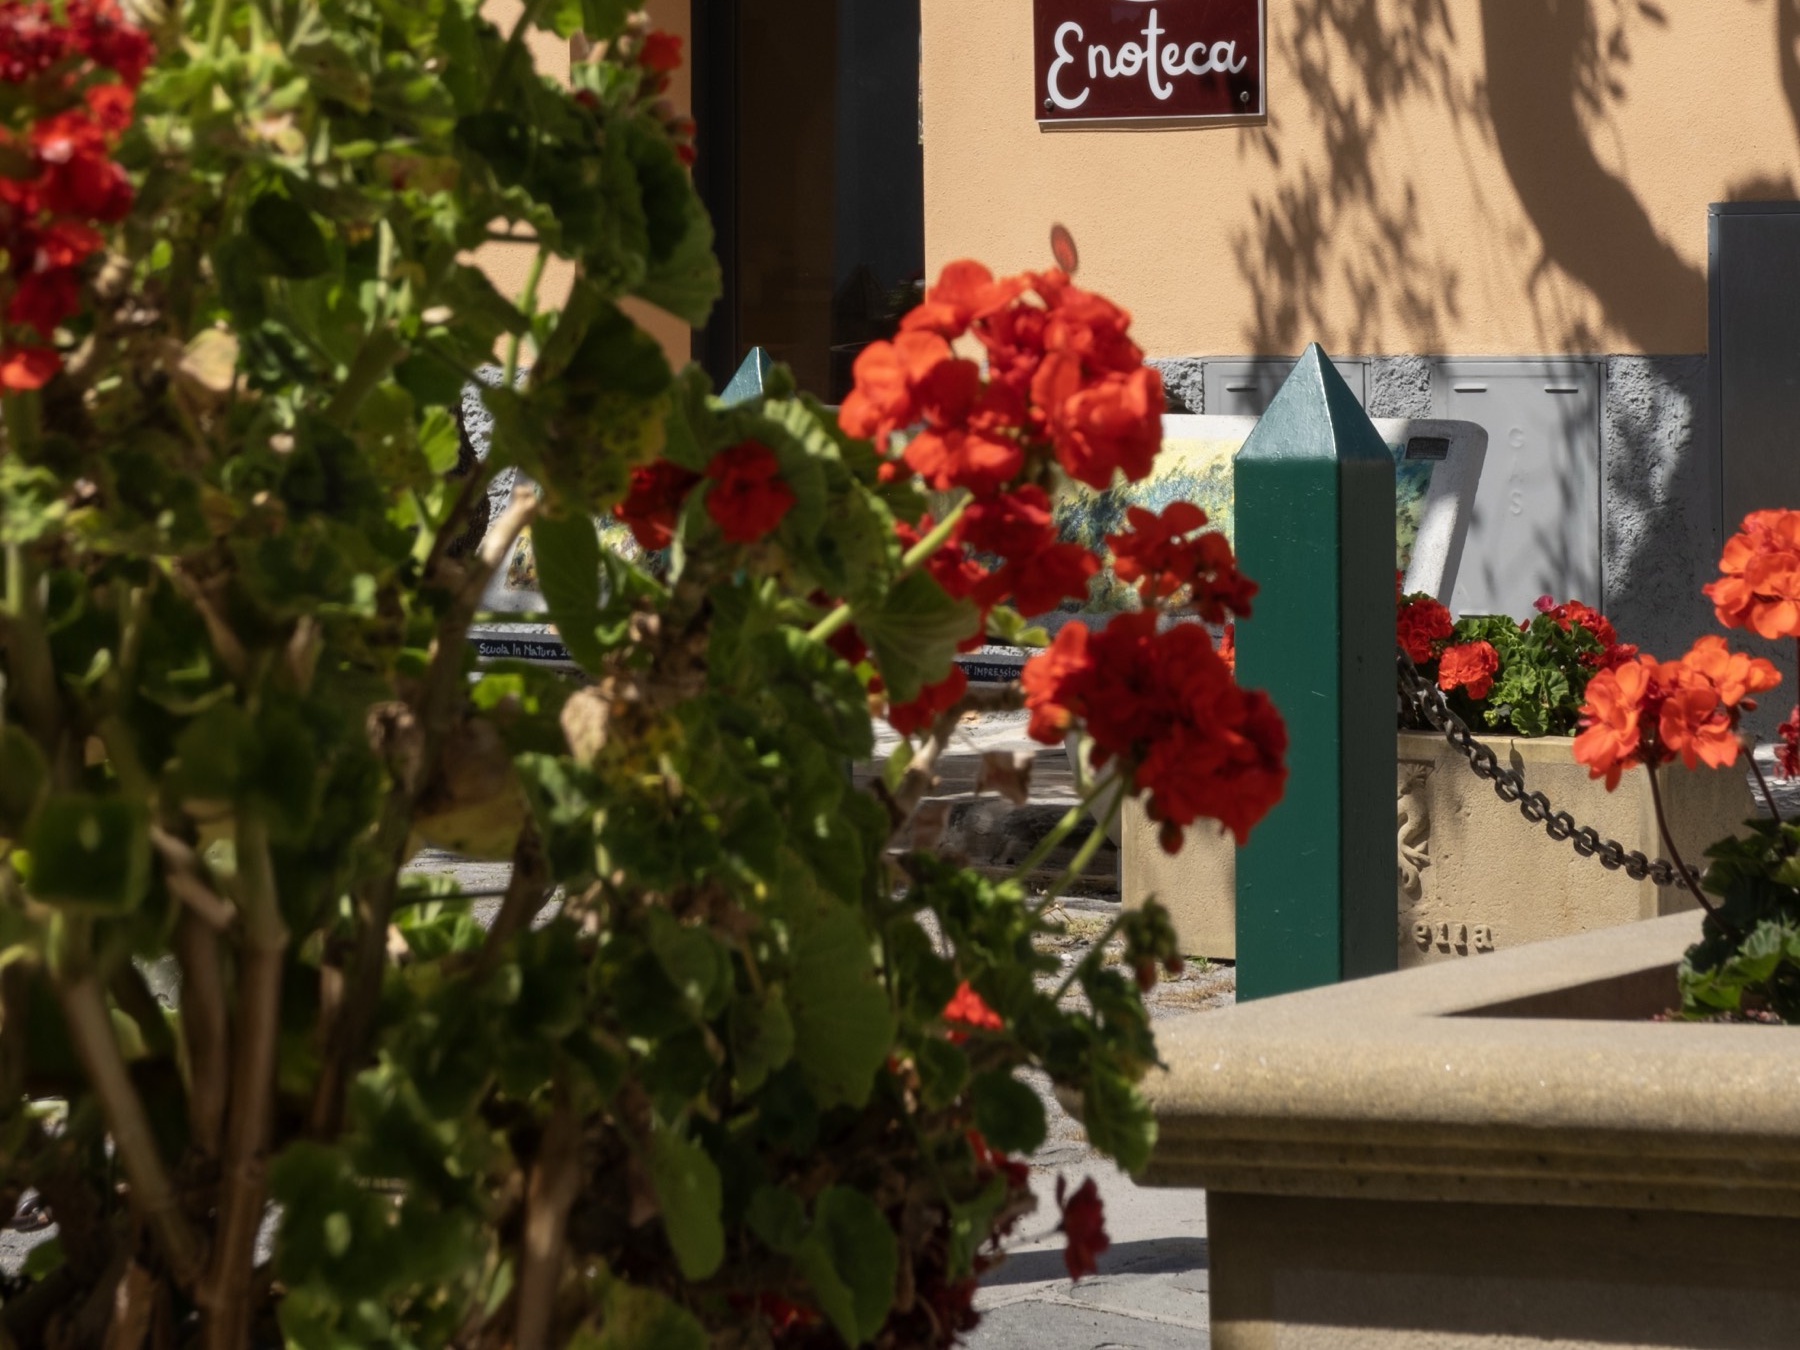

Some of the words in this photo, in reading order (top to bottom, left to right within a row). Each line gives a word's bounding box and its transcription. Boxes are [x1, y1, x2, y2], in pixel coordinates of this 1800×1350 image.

[1047, 7, 1248, 110] Enoteca
[479, 642, 510, 655] Scuola
[524, 644, 558, 658] Natura
